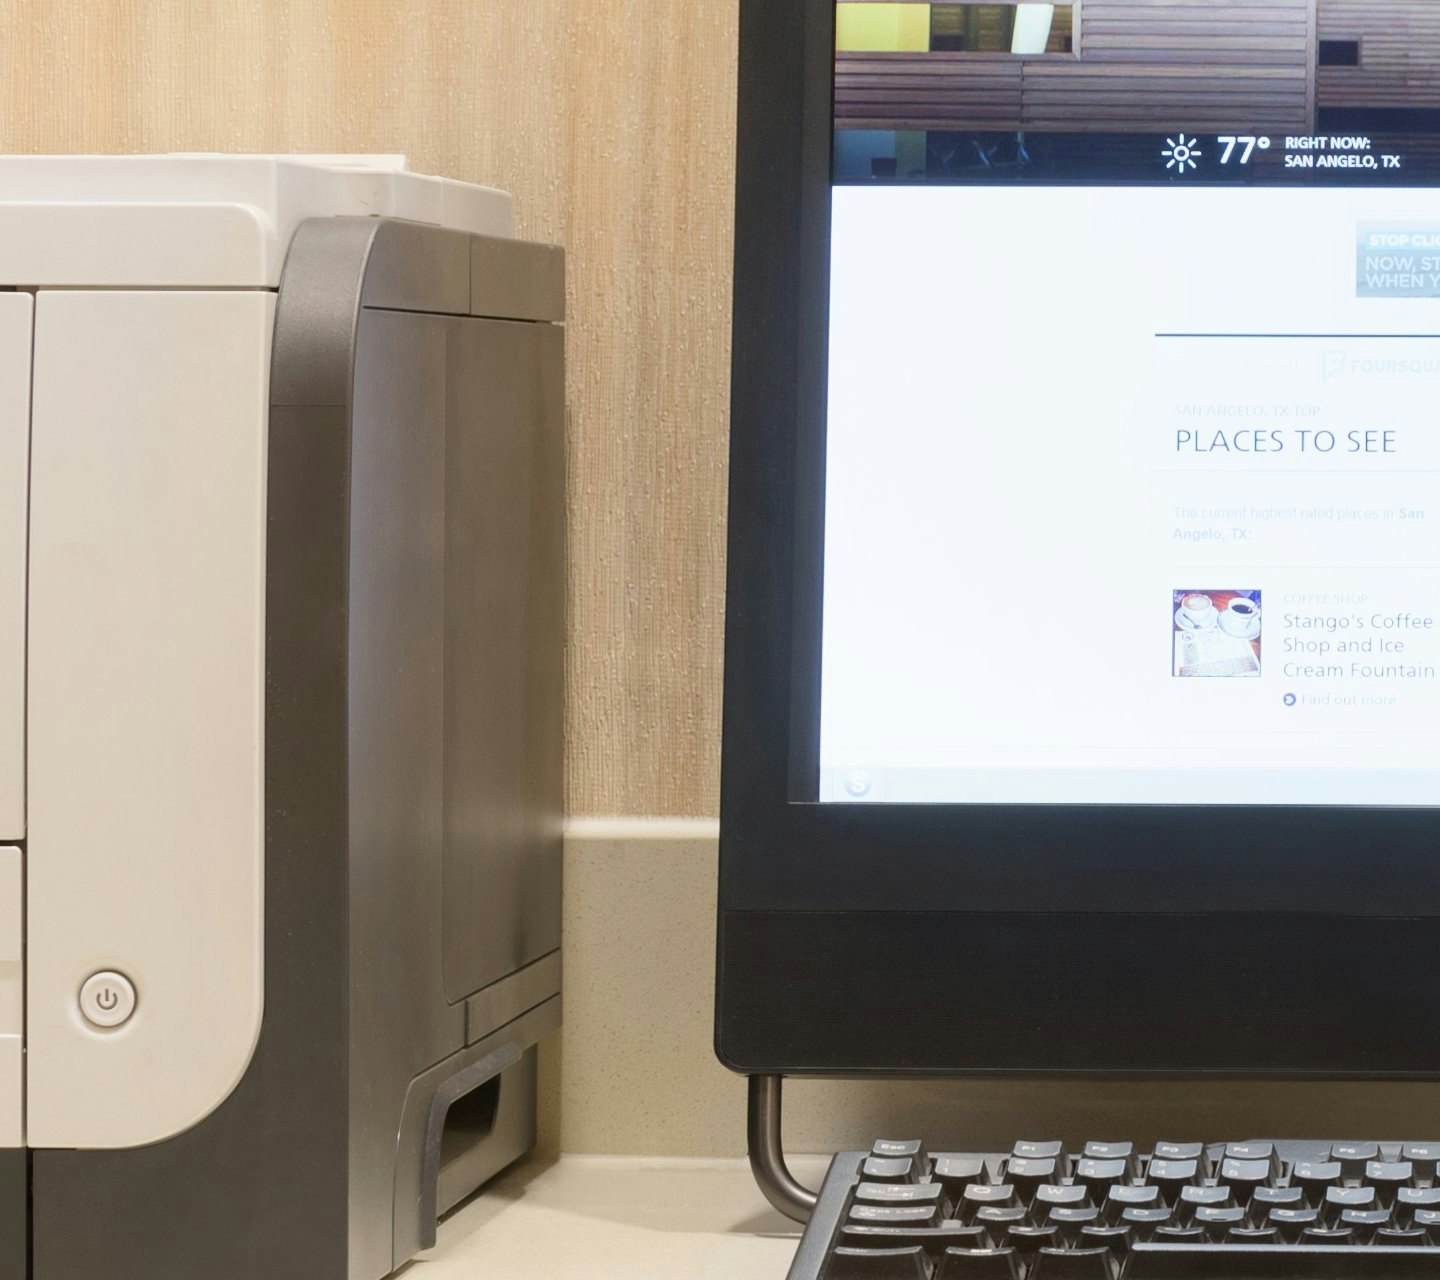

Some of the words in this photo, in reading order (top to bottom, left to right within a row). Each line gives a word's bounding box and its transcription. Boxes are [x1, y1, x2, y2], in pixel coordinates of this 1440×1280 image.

[1217, 136, 1271, 164] 77°
[1285, 136, 1327, 150] RIGHT
[1330, 136, 1371, 150] NOW:
[1284, 154, 1314, 168] SAN
[1316, 154, 1378, 169] ANGELO,
[1380, 154, 1401, 168] TX
[1368, 233, 1409, 247] STOP
[1365, 256, 1415, 272] NOW,
[1365, 273, 1424, 288] WHEN
[1174, 405, 1201, 417] SAN
[1272, 405, 1289, 417] TX
[1294, 405, 1321, 417] TOP
[1175, 428, 1285, 454] PLACES
[1294, 429, 1337, 454] TO
[1346, 429, 1398, 454] SEE
[1174, 506, 1198, 520] The
[1201, 507, 1247, 520] current
[1250, 506, 1297, 523] highest
[1301, 507, 1334, 520] rated
[1337, 507, 1379, 523] places
[1382, 507, 1395, 520] in
[1398, 507, 1425, 521] San
[1172, 528, 1226, 542] Angelo,
[1231, 528, 1254, 540] TX:
[1282, 612, 1365, 633] Stango's
[1369, 612, 1434, 630] Coffee
[1282, 637, 1331, 656] Shop
[1336, 637, 1373, 653] and
[1379, 637, 1405, 653] Ice
[1282, 662, 1344, 678] Cream
[1351, 662, 1436, 678] Fountain
[1301, 693, 1331, 706] Find
[1333, 694, 1358, 706] out
[1361, 696, 1397, 706] more
[1047, 1187, 1064, 1195] W
